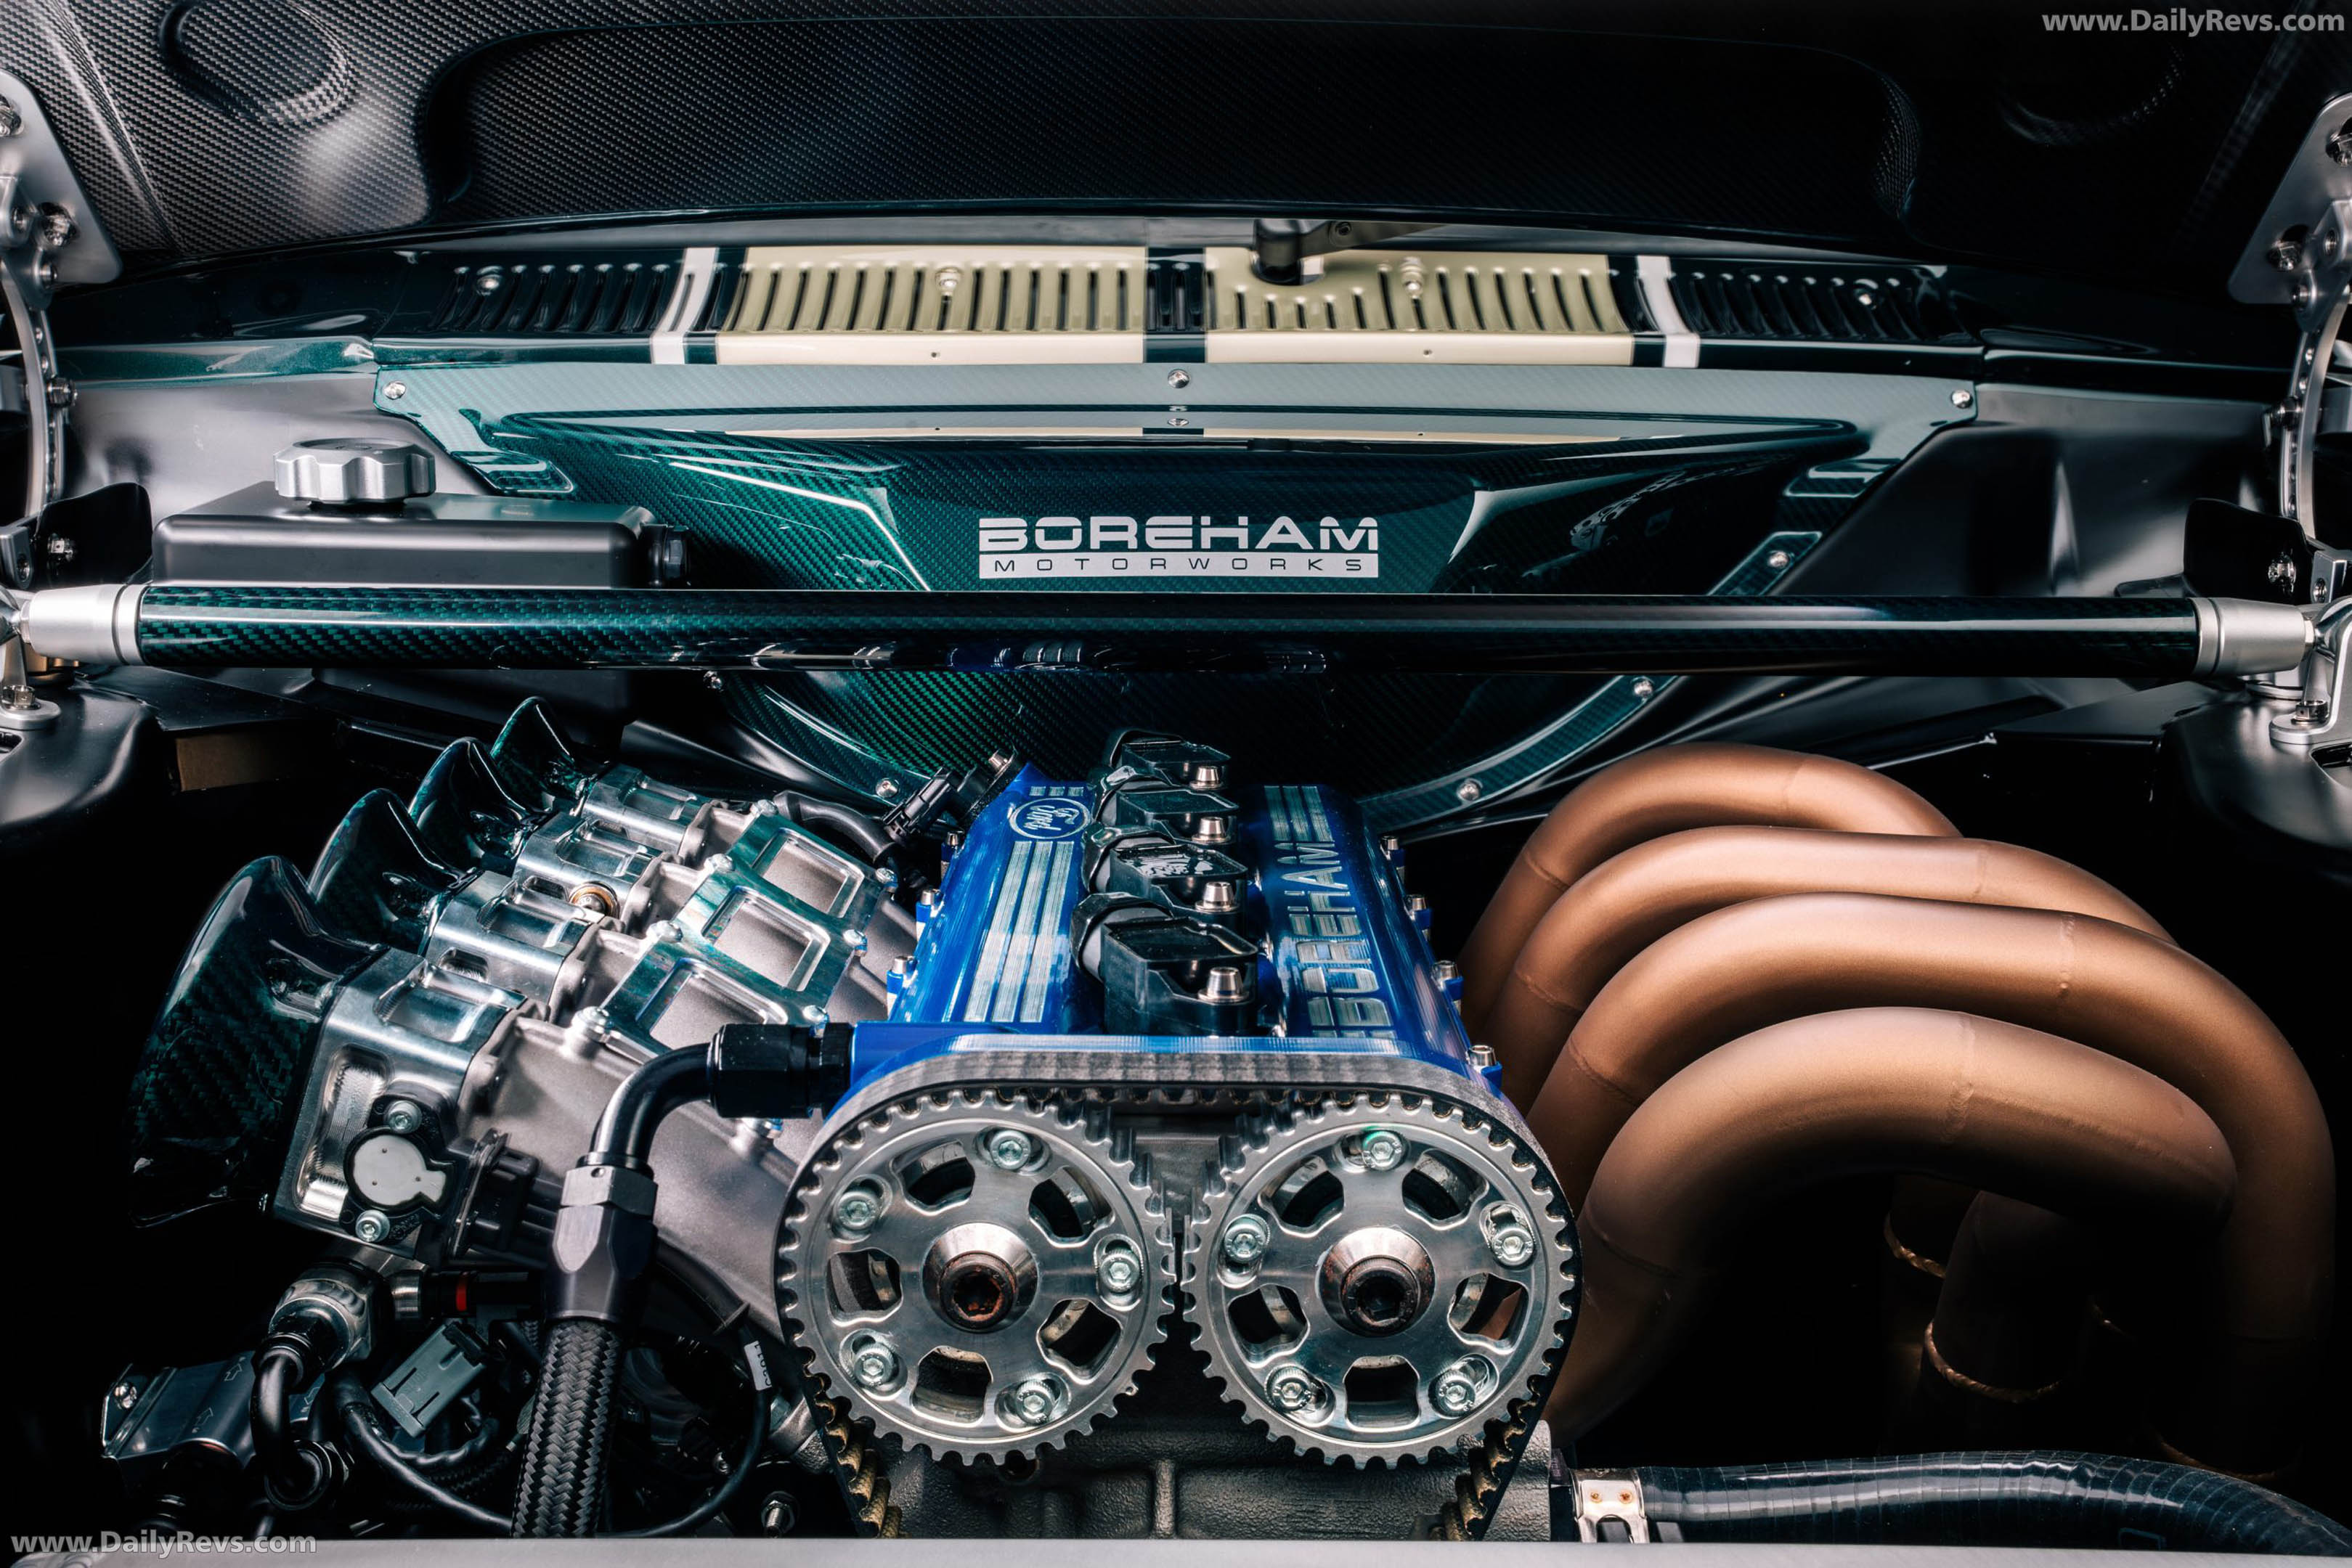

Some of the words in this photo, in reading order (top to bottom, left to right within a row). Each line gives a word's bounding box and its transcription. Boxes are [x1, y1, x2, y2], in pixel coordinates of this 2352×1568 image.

[979, 516, 1378, 550] BOREHAM
[994, 558, 1362, 572] MOTORWORKS
[1274, 841, 1393, 1026] BOREHAM
